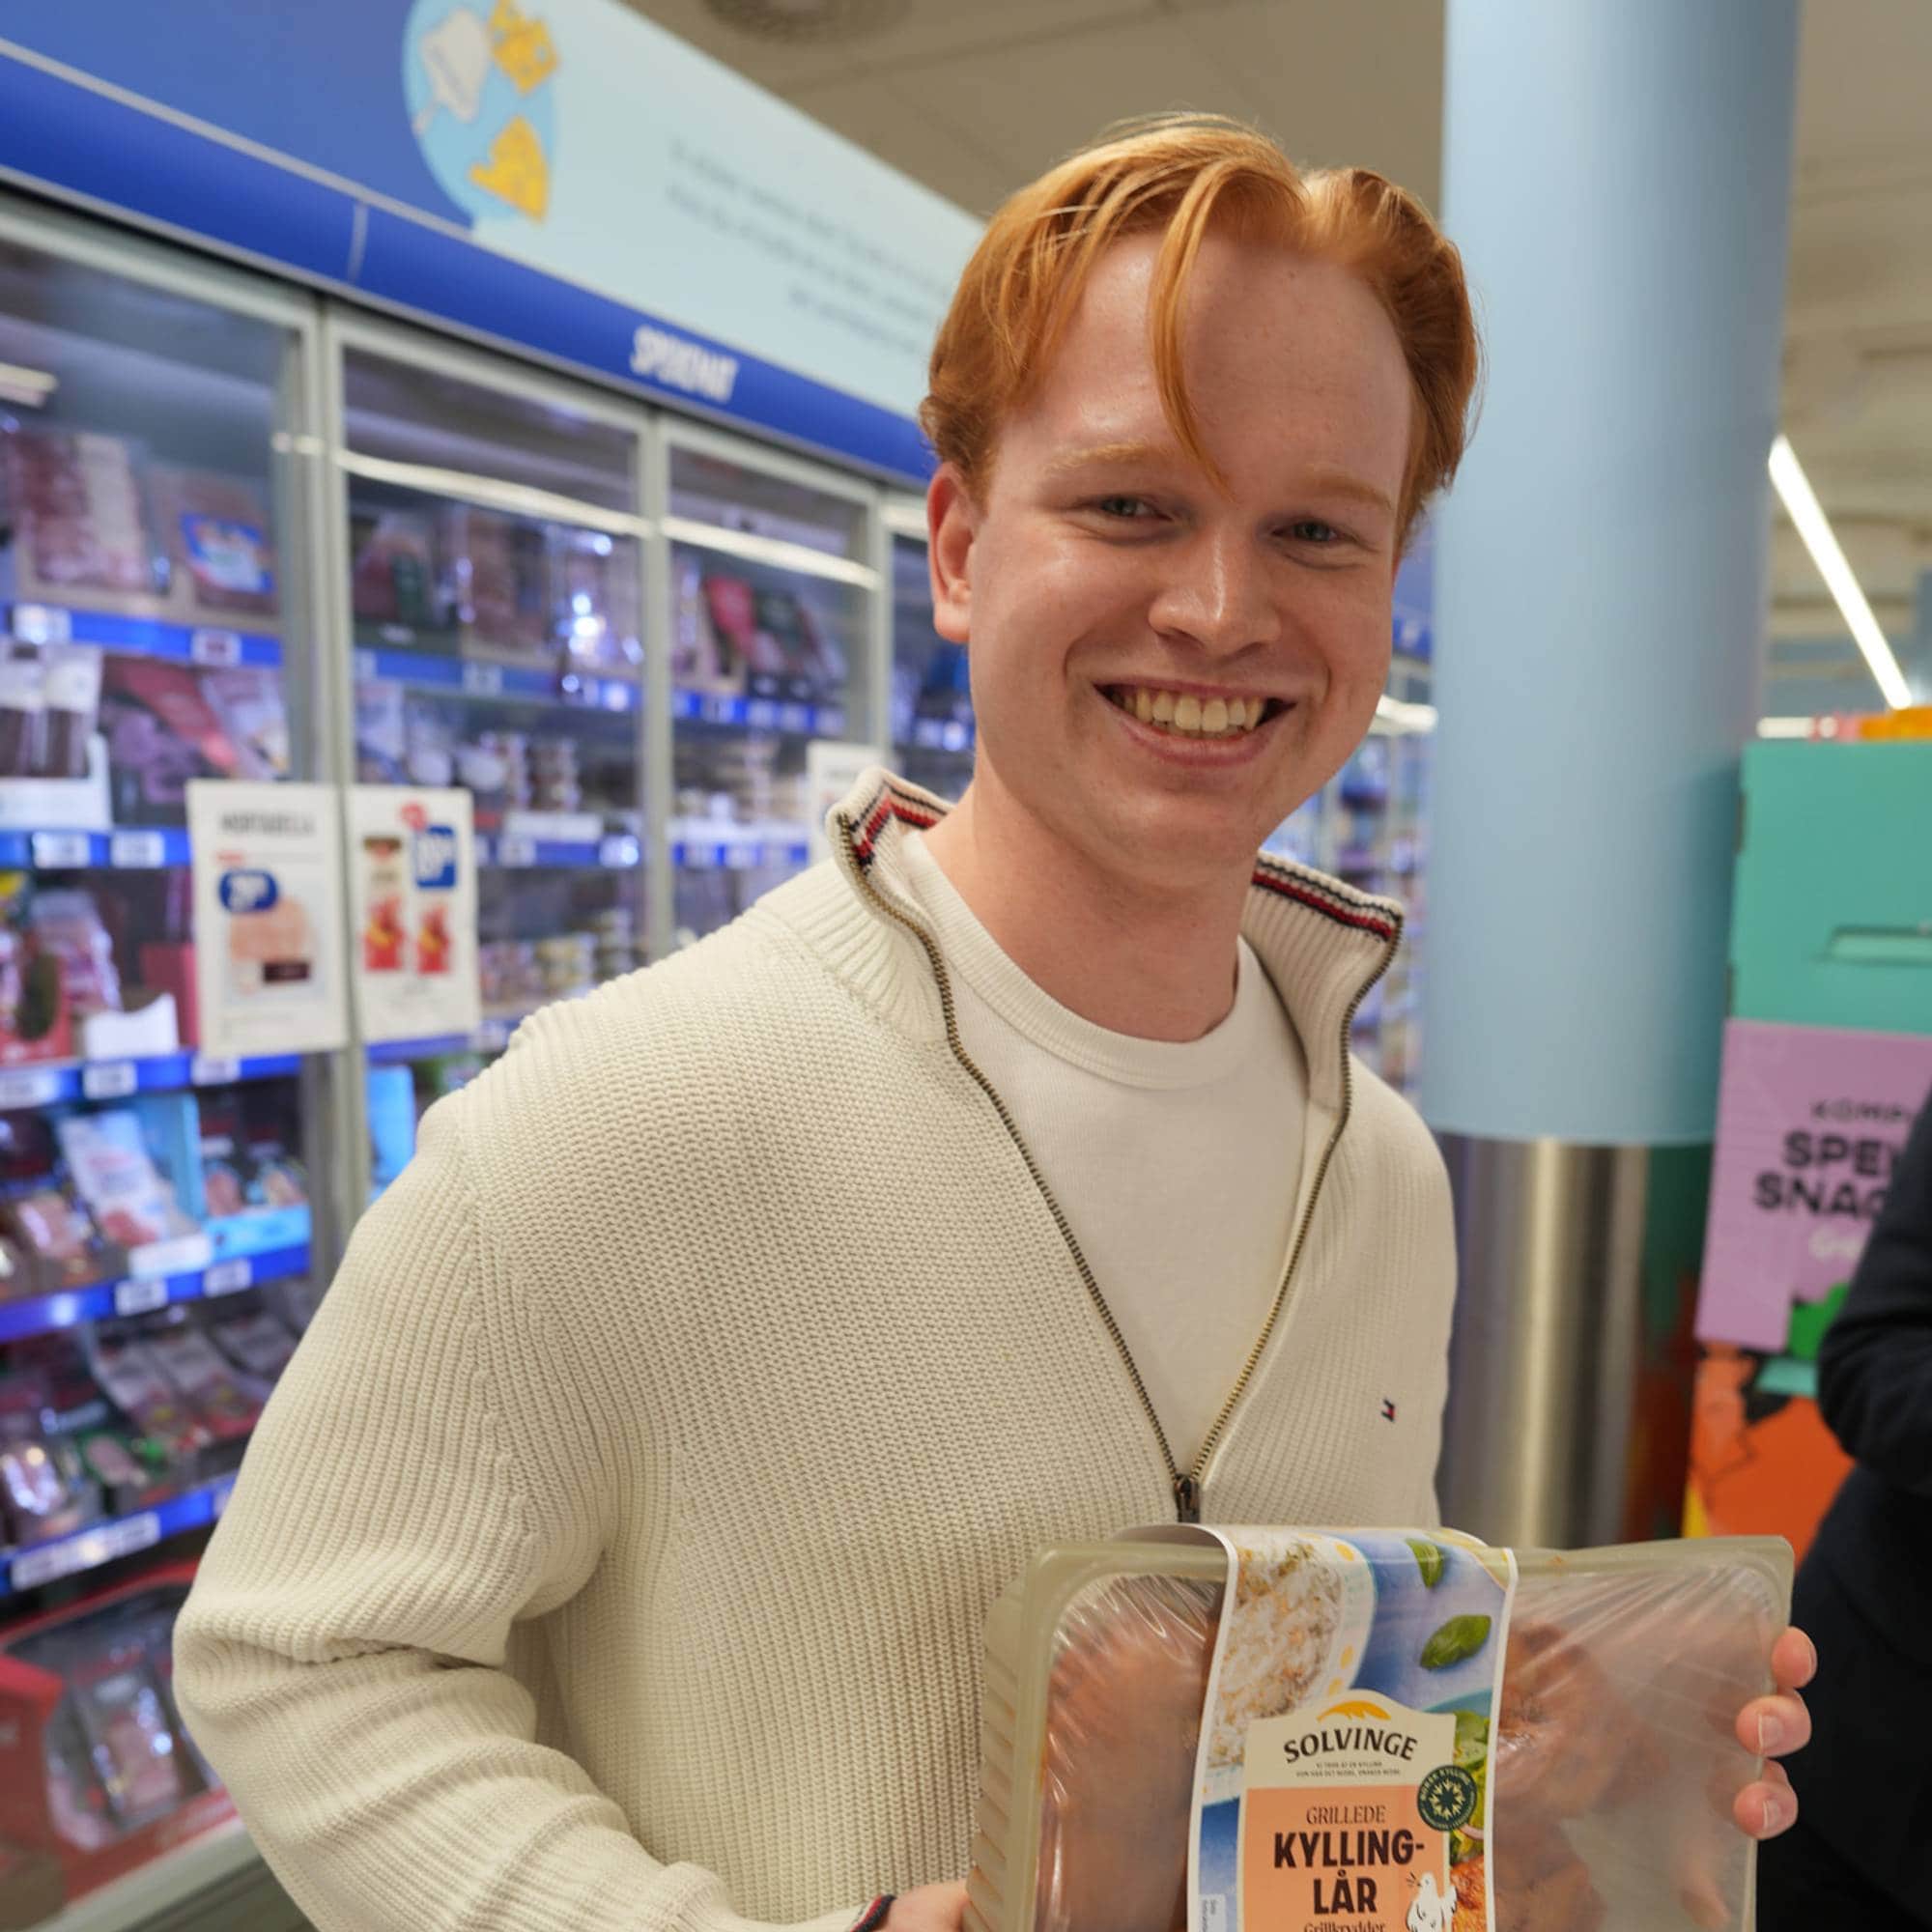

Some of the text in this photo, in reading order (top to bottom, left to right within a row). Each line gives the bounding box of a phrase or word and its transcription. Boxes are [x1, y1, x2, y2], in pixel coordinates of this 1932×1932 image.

[1809, 1099, 1904, 1123] KOMP
[1782, 1129, 1899, 1179] SPE
[1283, 1727, 1418, 1764] SOLVINGE
[1306, 1804, 1386, 1825] GRILLEDE
[1273, 1829, 1425, 1868] KYLLING-
[1313, 1868, 1378, 1915] LÅR
